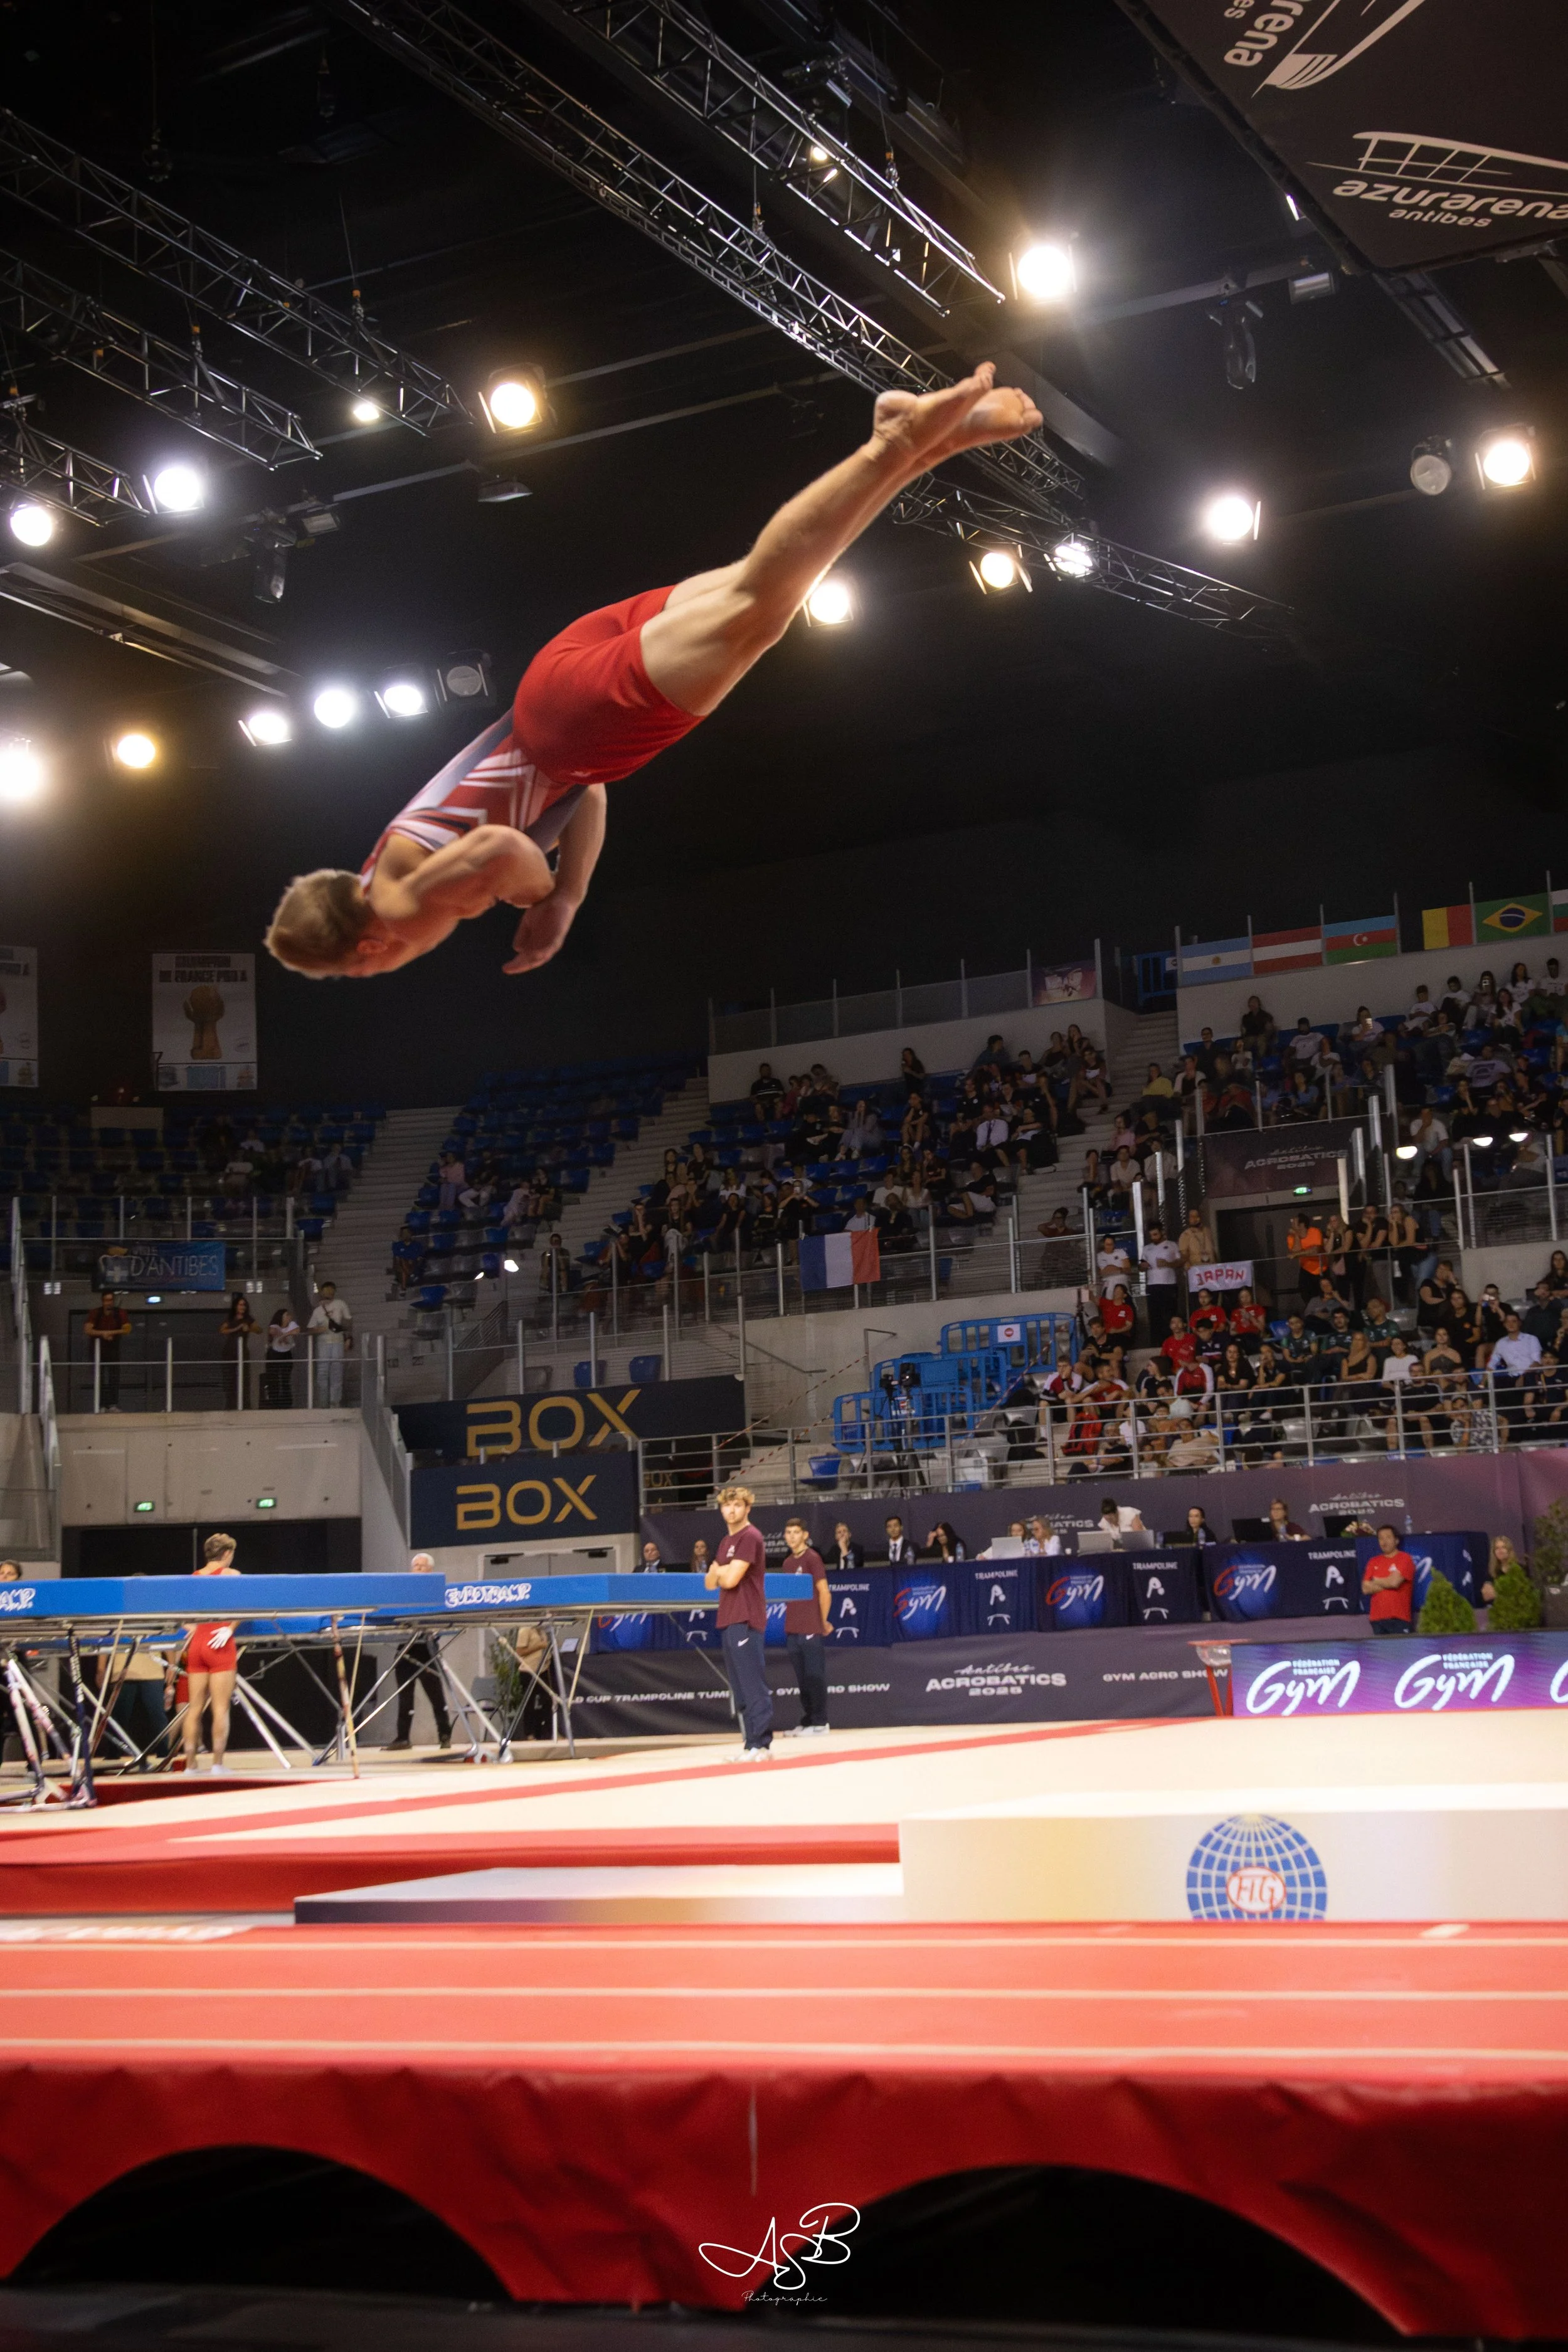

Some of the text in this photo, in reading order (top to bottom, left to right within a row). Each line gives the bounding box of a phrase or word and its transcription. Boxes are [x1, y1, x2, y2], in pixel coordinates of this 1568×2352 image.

[1389, 209, 1492, 227] antibes
[130, 1254, 219, 1277] D'ANTIBES
[1195, 1268, 1244, 1286] JAPAN
[467, 1389, 641, 1456] BOX
[456, 1475, 598, 1530] BOX
[1308, 1498, 1405, 1513] ACROBATICS
[1308, 1550, 1356, 1560] TRAMPOLINE
[925, 1673, 1067, 1692] ACROBATICS
[1103, 1673, 1136, 1682] GYM
[1138, 1670, 1179, 1681] ACRO
[1394, 1654, 1515, 1711] Gym
[848, 1683, 891, 1693] SHOW
[1246, 1660, 1361, 1717] Gym
[586, 1695, 612, 1704] CUP
[614, 1692, 695, 1703] TRAMPOLINE
